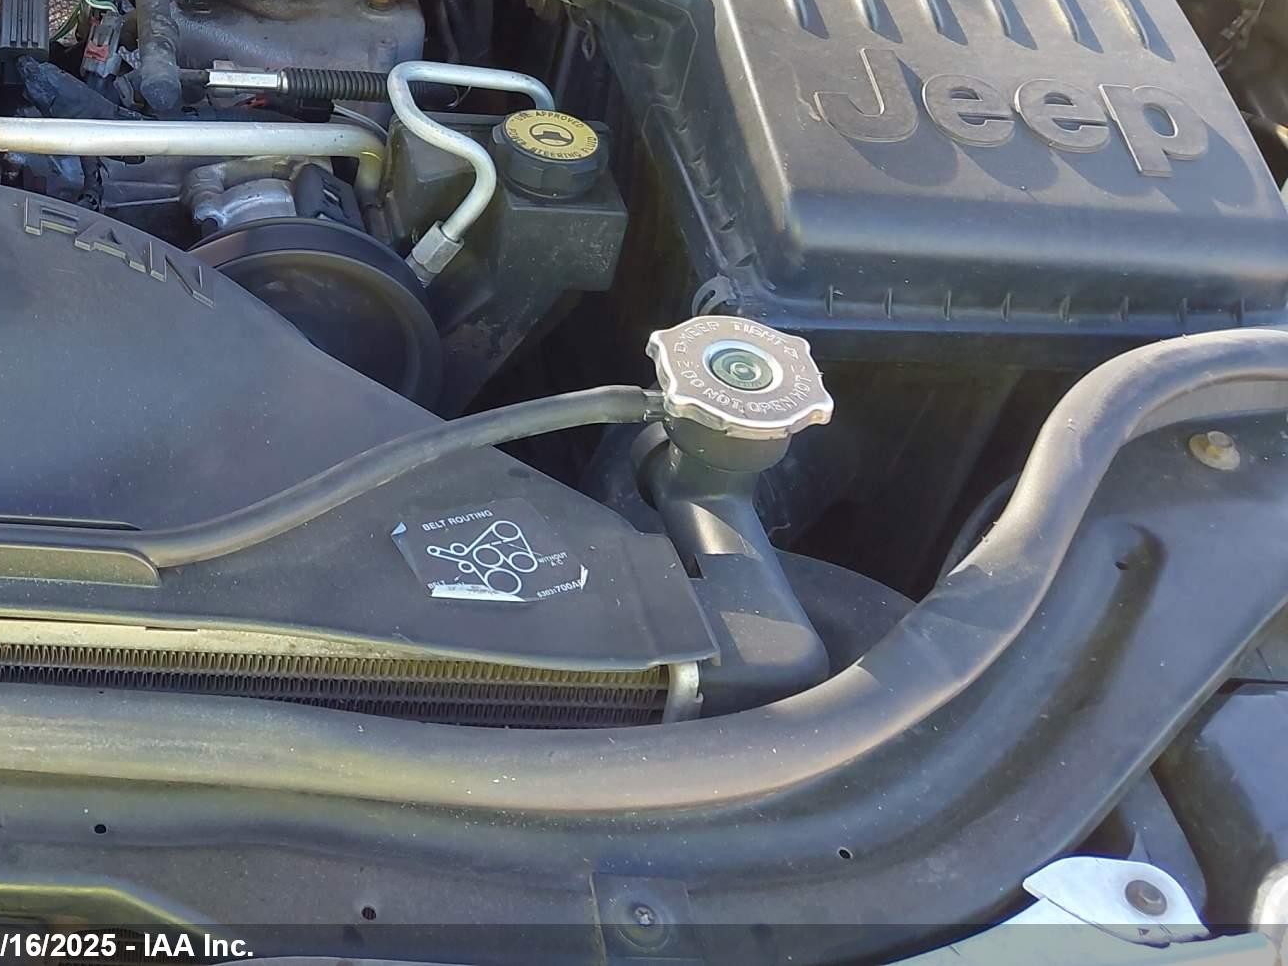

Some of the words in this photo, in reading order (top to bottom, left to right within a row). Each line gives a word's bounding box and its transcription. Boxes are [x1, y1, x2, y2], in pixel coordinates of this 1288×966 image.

[535, 111, 585, 128] APPROVED
[813, 47, 1209, 178] Jeep
[530, 146, 583, 159] STEERING
[23, 194, 219, 308] FAN
[681, 370, 705, 388] DO
[702, 387, 744, 410] NOT
[748, 395, 798, 414] OPEN
[421, 519, 447, 532] BELT
[448, 509, 493, 526] ROUTING
[538, 552, 568, 564] WITHOUT
